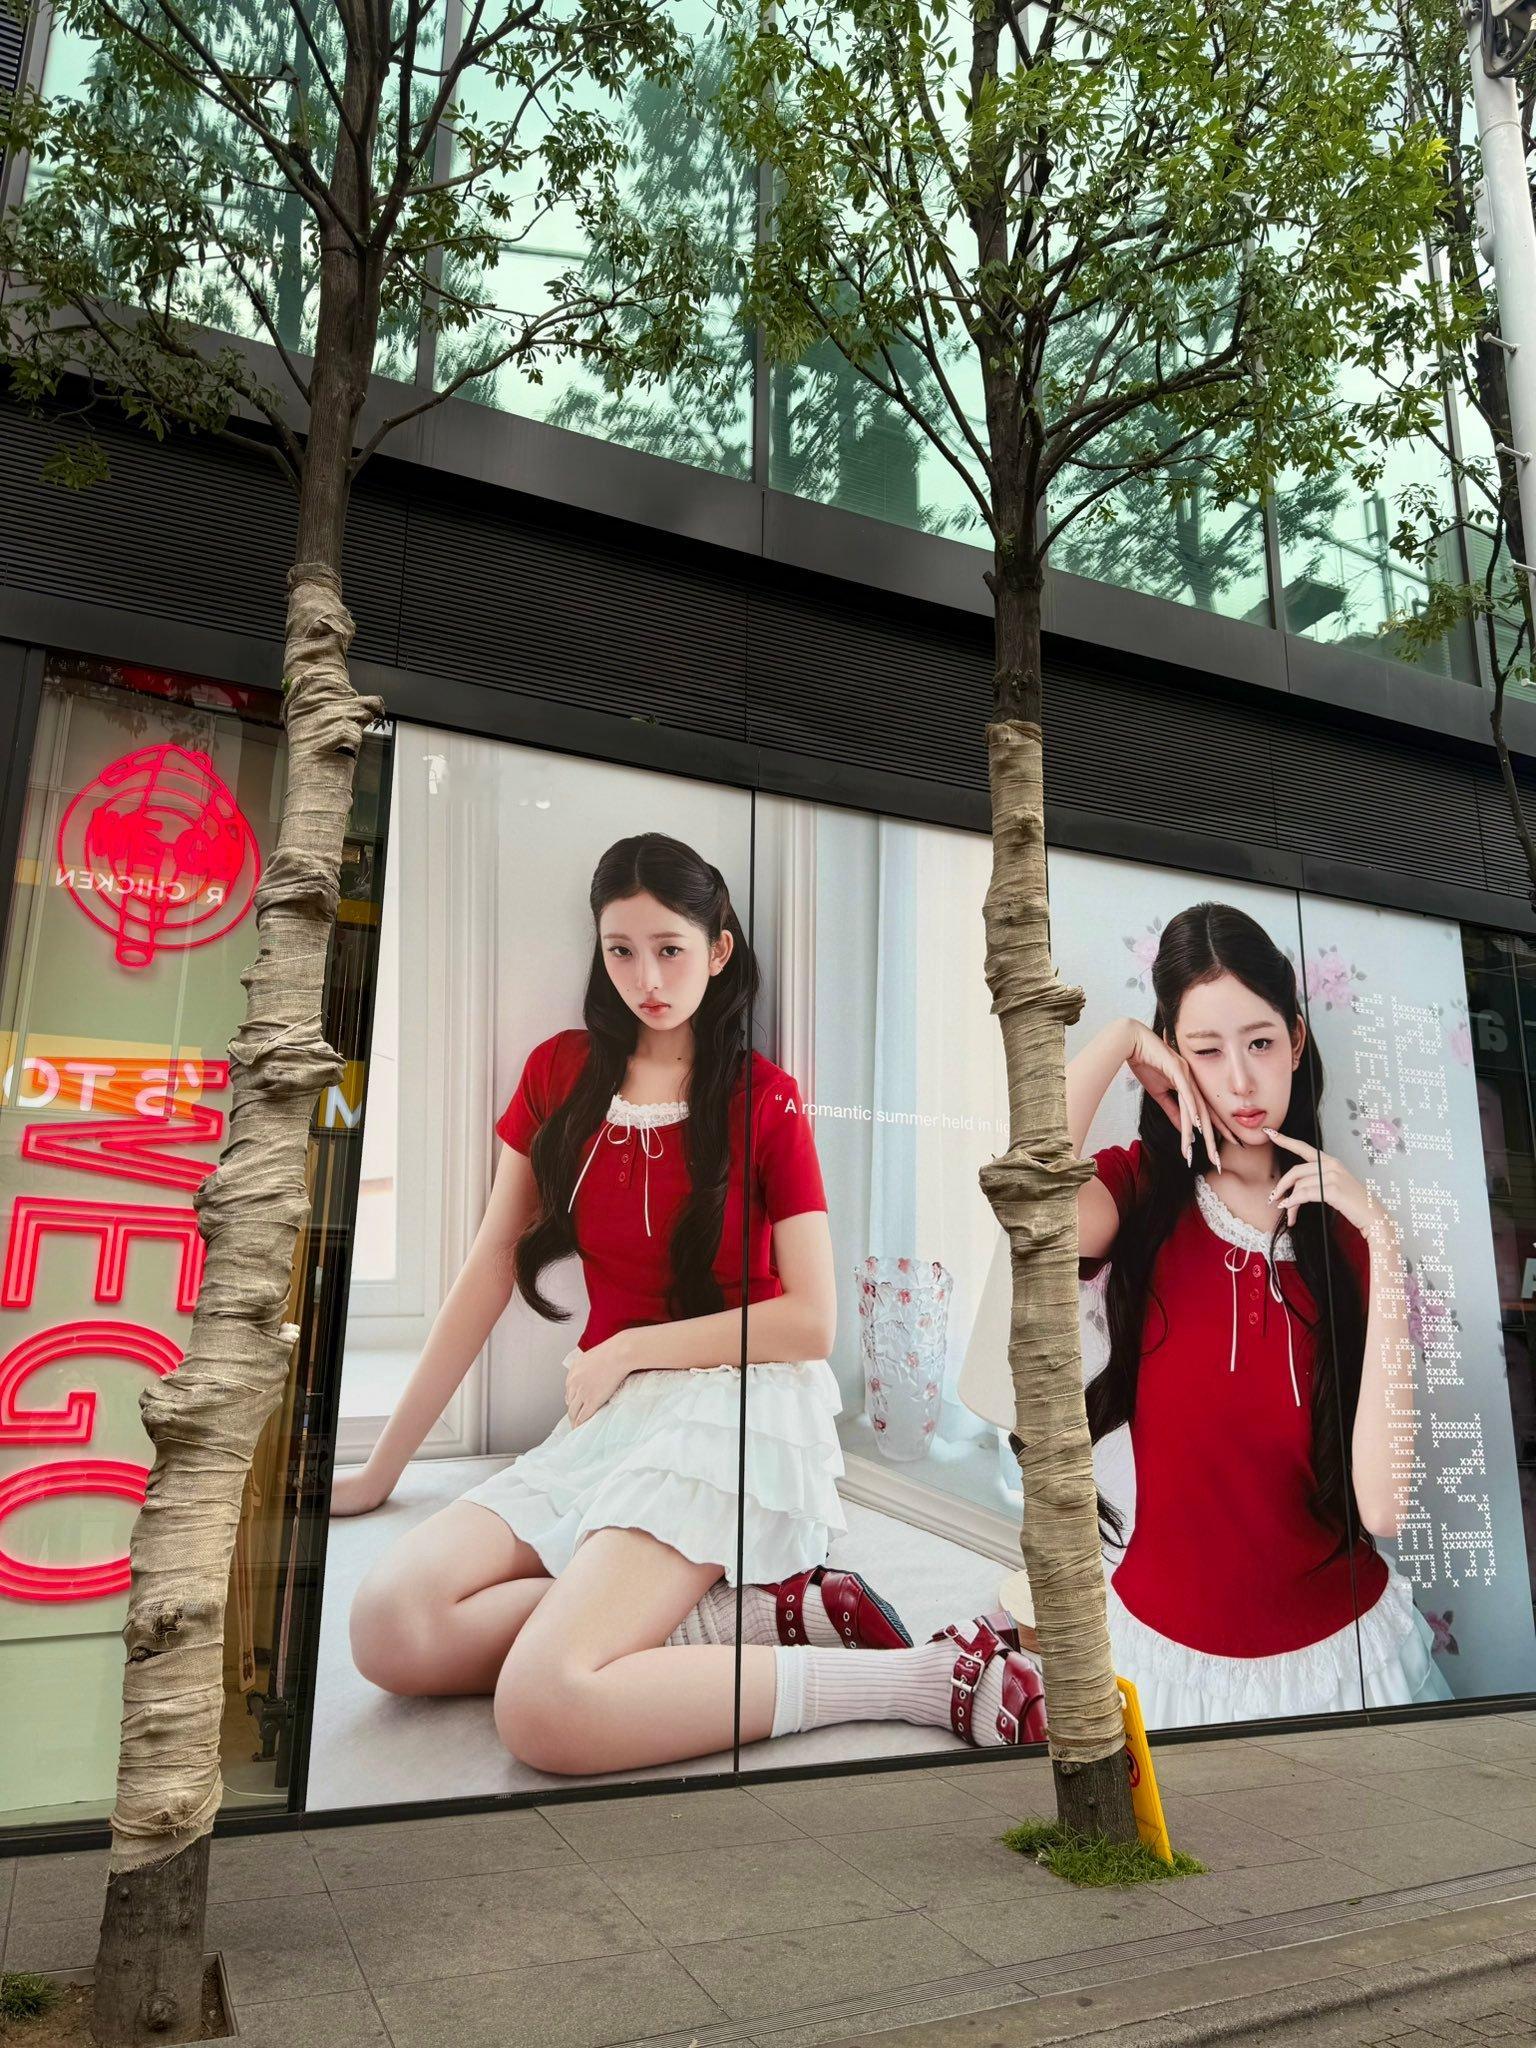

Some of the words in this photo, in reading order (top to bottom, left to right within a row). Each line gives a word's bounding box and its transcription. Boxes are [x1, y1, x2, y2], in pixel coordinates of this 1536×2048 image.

[802, 1103, 872, 1121] romantic
[876, 1110, 939, 1128] summer
[942, 1114, 974, 1130] held
[978, 1118, 991, 1131] in
[1392, 995, 1453, 1160] REI
[0, 1058, 230, 1607] WEGO
[1350, 993, 1397, 1165] WEGO
[1380, 1336, 1437, 1589] SUMMER
[1408, 1178, 1465, 1394] from
[1431, 1412, 1497, 1588] IVE
